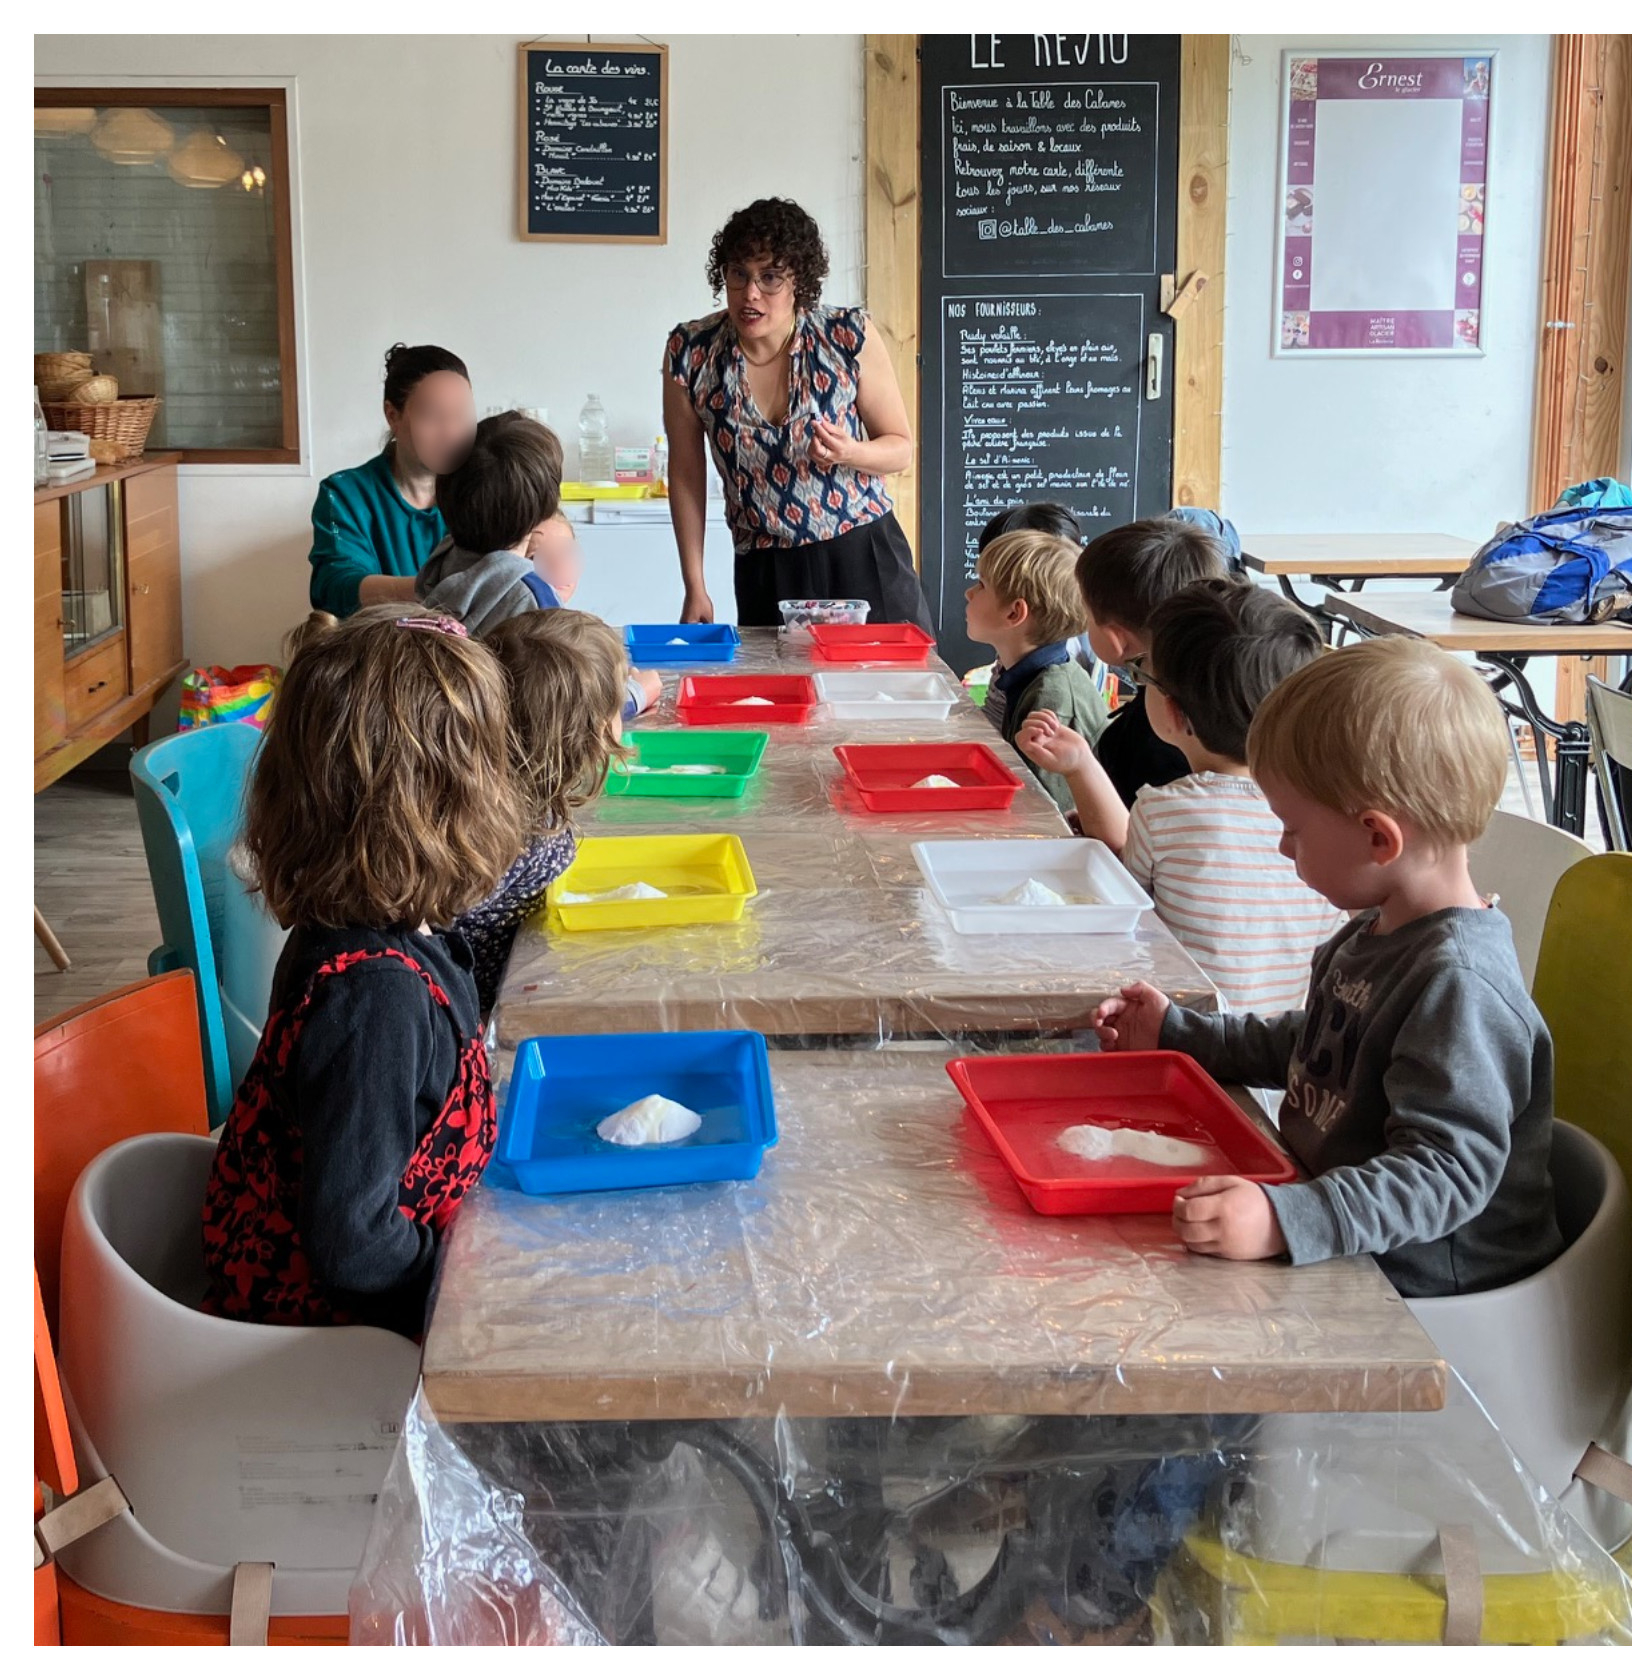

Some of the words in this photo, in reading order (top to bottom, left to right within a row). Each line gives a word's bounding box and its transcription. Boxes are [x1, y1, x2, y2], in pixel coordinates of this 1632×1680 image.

[970, 34, 1005, 68] LE
[545, 59, 564, 73] La
[566, 58, 597, 74] carte
[601, 60, 620, 74] des
[1358, 62, 1423, 90] Ernest
[950, 91, 998, 112] Bienvenue
[1006, 98, 1013, 108] à
[1016, 91, 1028, 108] la
[1029, 90, 1055, 109] Table
[1064, 92, 1082, 108] des
[1086, 88, 1126, 109] Cabanes
[971, 122, 997, 133] nous
[1002, 116, 1052, 134] travaillons
[1056, 122, 1075, 132] avec
[1079, 116, 1096, 133] des
[1100, 116, 1141, 140] produits
[953, 136, 980, 158] frais,
[982, 138, 995, 152] de
[998, 140, 1033, 152] saison
[1038, 141, 1046, 152] &
[954, 158, 1004, 186] Retrouvez
[1010, 160, 1040, 176] notre
[1042, 161, 1072, 178] carte,
[1074, 158, 1124, 184] différente
[956, 180, 980, 198] tous
[986, 180, 1001, 196] les
[1006, 182, 1038, 206] jours,
[1040, 184, 1058, 193] sur
[1062, 184, 1080, 193] nos
[1084, 182, 1121, 192] réseaux
[956, 204, 988, 217] sociaux
[948, 304, 966, 318] NOS
[990, 325, 1022, 340] volaille
[979, 342, 1008, 357] poulets
[1080, 340, 1098, 356] plein
[1101, 344, 1118, 354] air,
[961, 354, 978, 364] sont
[988, 384, 997, 394] et
[1084, 380, 1120, 398] fromages
[962, 396, 979, 408] lait
[1021, 428, 1034, 438] des
[1036, 426, 1069, 441] produits
[1100, 427, 1110, 438] de
[979, 452, 991, 464] sel
[996, 469, 1008, 479] est
[1095, 468, 1104, 478] de
[964, 479, 974, 490] de
[978, 479, 990, 490] sel
[992, 480, 1000, 489] et
[1002, 480, 1012, 488] de
